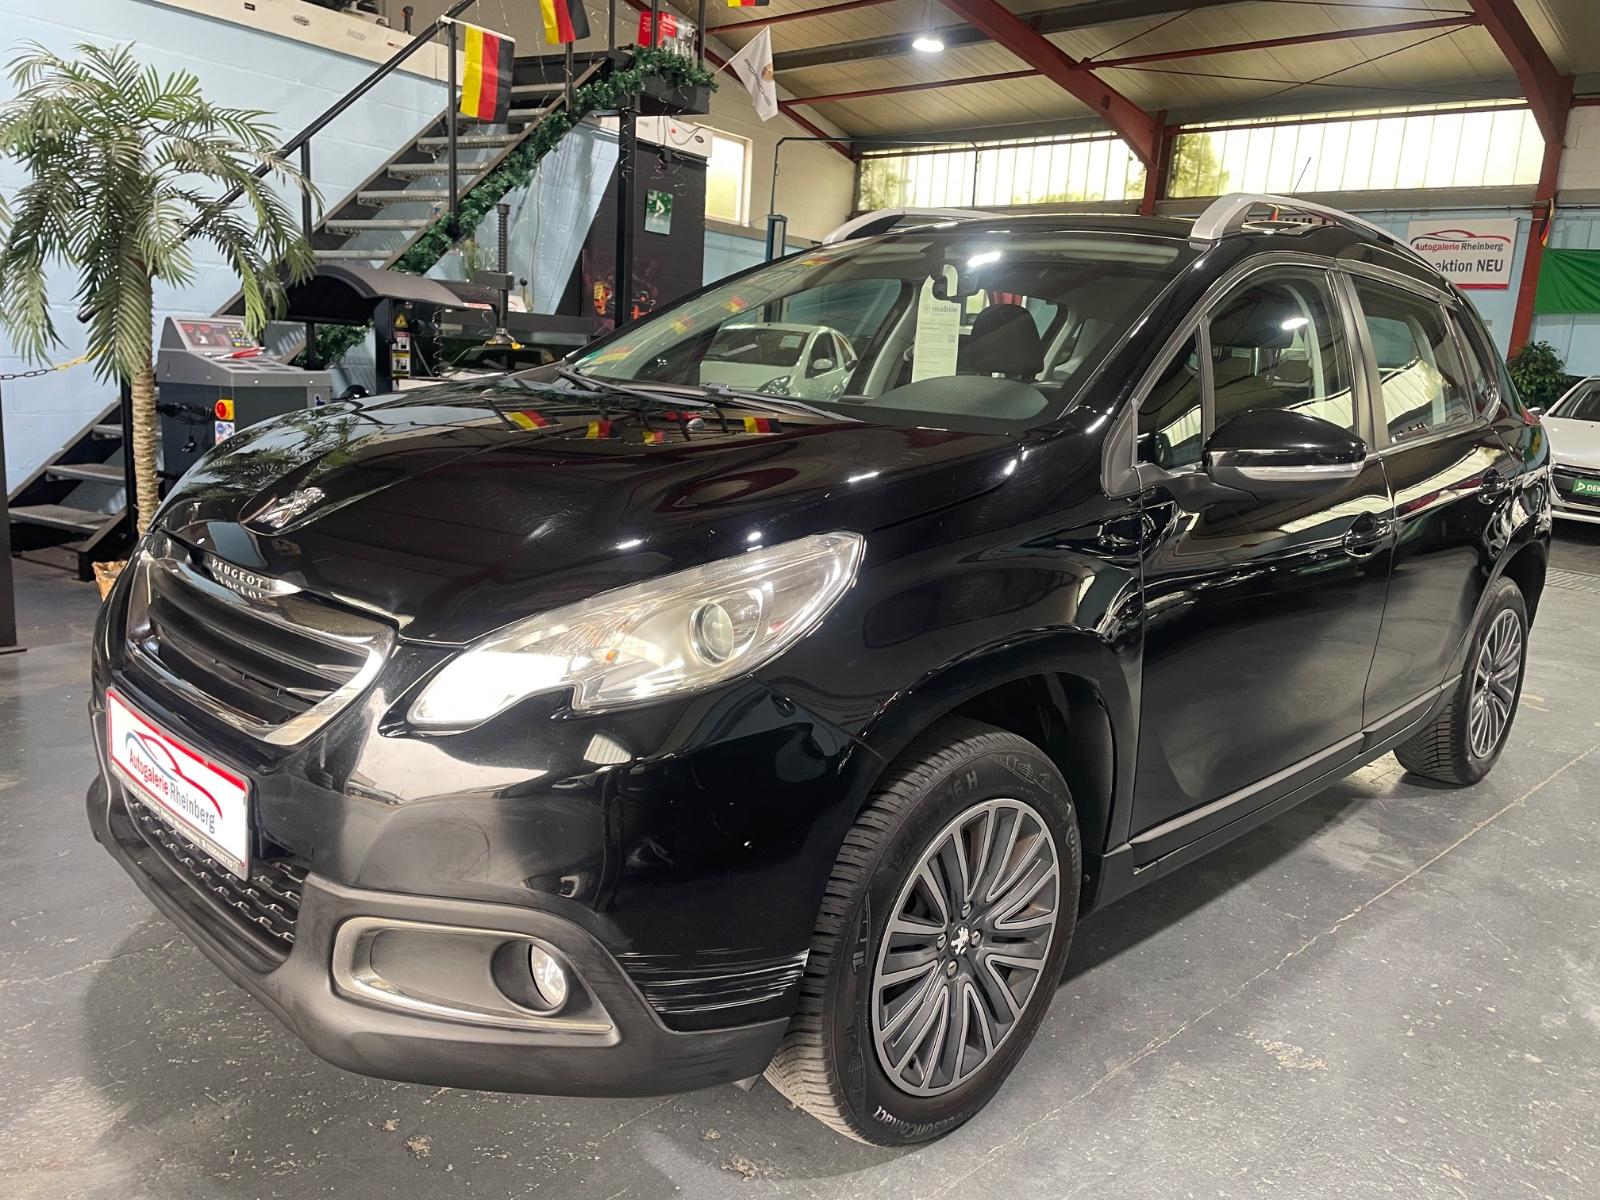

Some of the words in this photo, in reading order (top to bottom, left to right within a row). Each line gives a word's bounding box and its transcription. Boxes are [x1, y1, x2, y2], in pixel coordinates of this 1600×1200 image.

[1414, 242, 1460, 253] Autogalerie
[1461, 242, 1504, 252] Rheinberg
[1435, 259, 1473, 273] ektion
[1476, 259, 1504, 272] NEU
[211, 558, 264, 588] PEUGEOT
[129, 748, 169, 796] Autogalerie
[169, 781, 216, 835] Rheinberg
